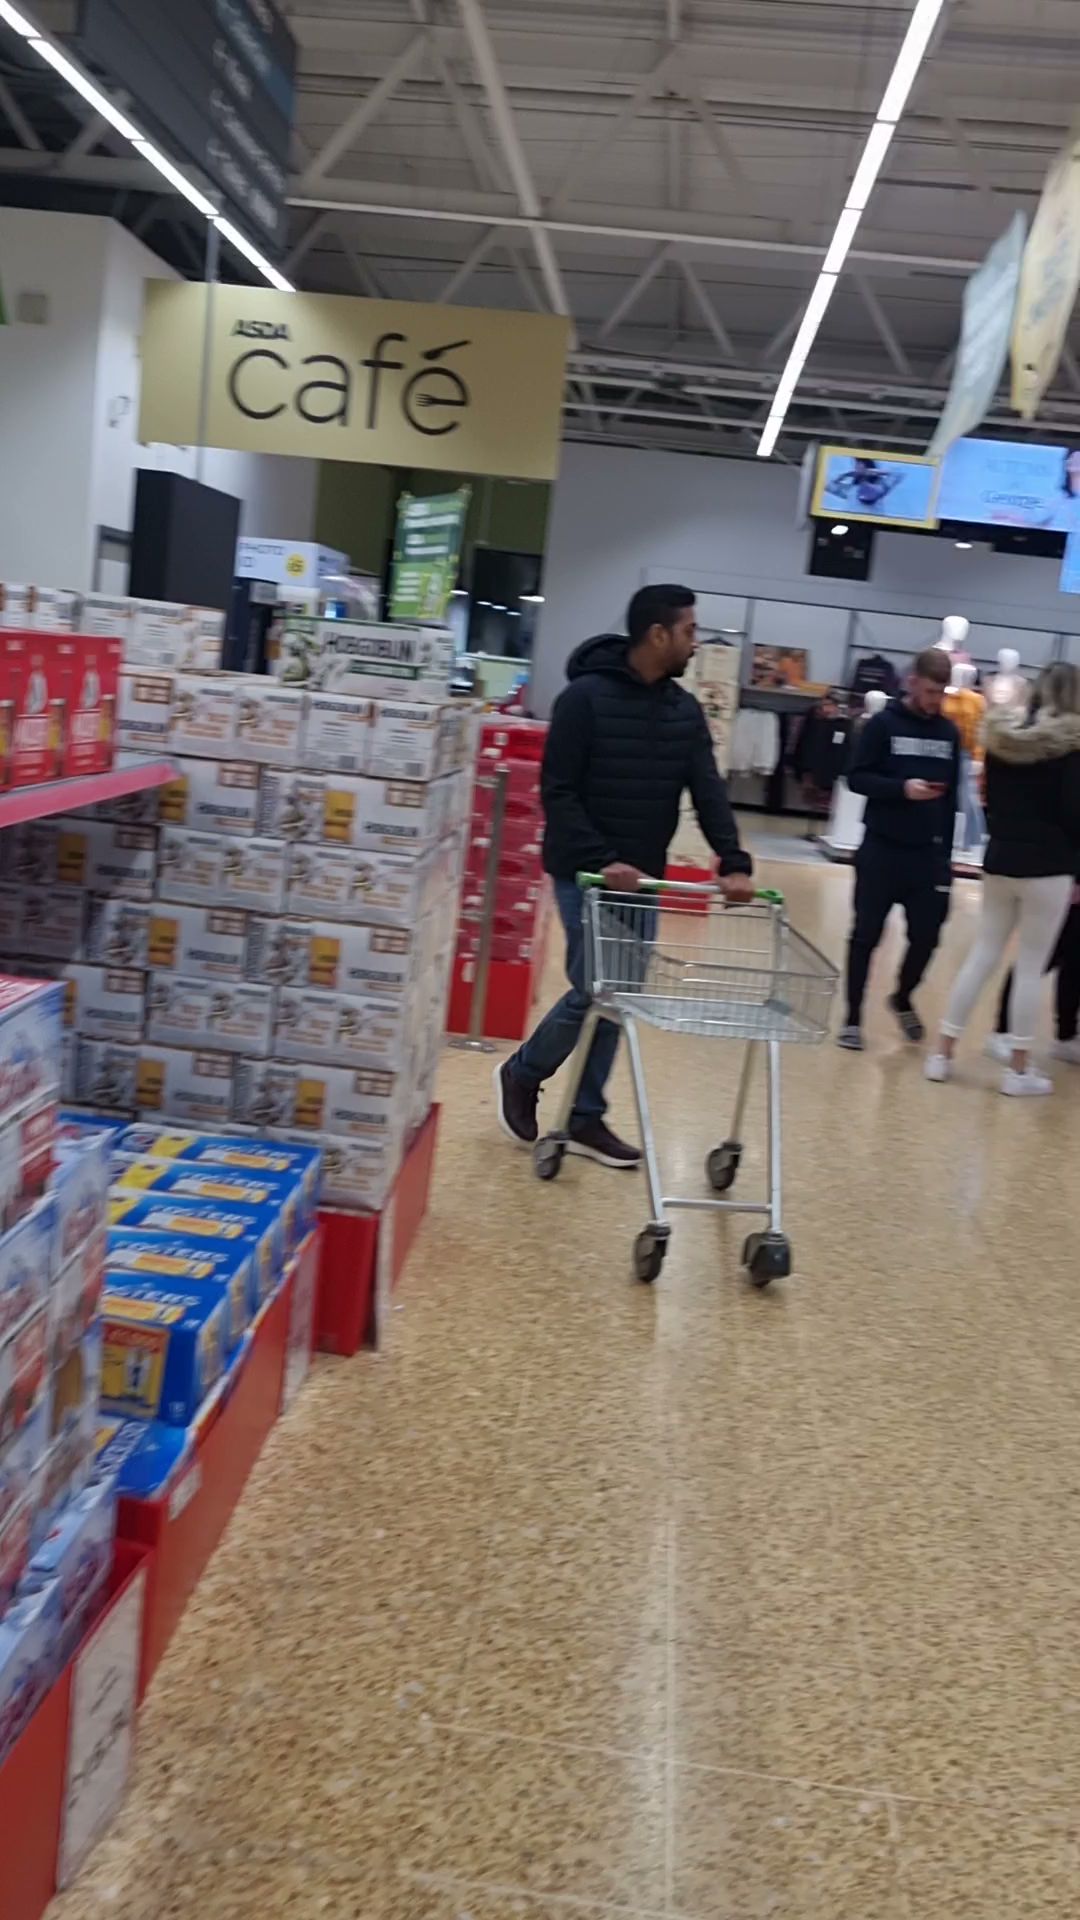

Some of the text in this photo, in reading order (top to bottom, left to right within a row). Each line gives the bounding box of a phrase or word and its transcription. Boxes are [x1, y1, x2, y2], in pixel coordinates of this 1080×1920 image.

[231, 319, 292, 340] ASDA
[228, 333, 471, 436] café
[321, 631, 417, 665] HOBGOBLIN
